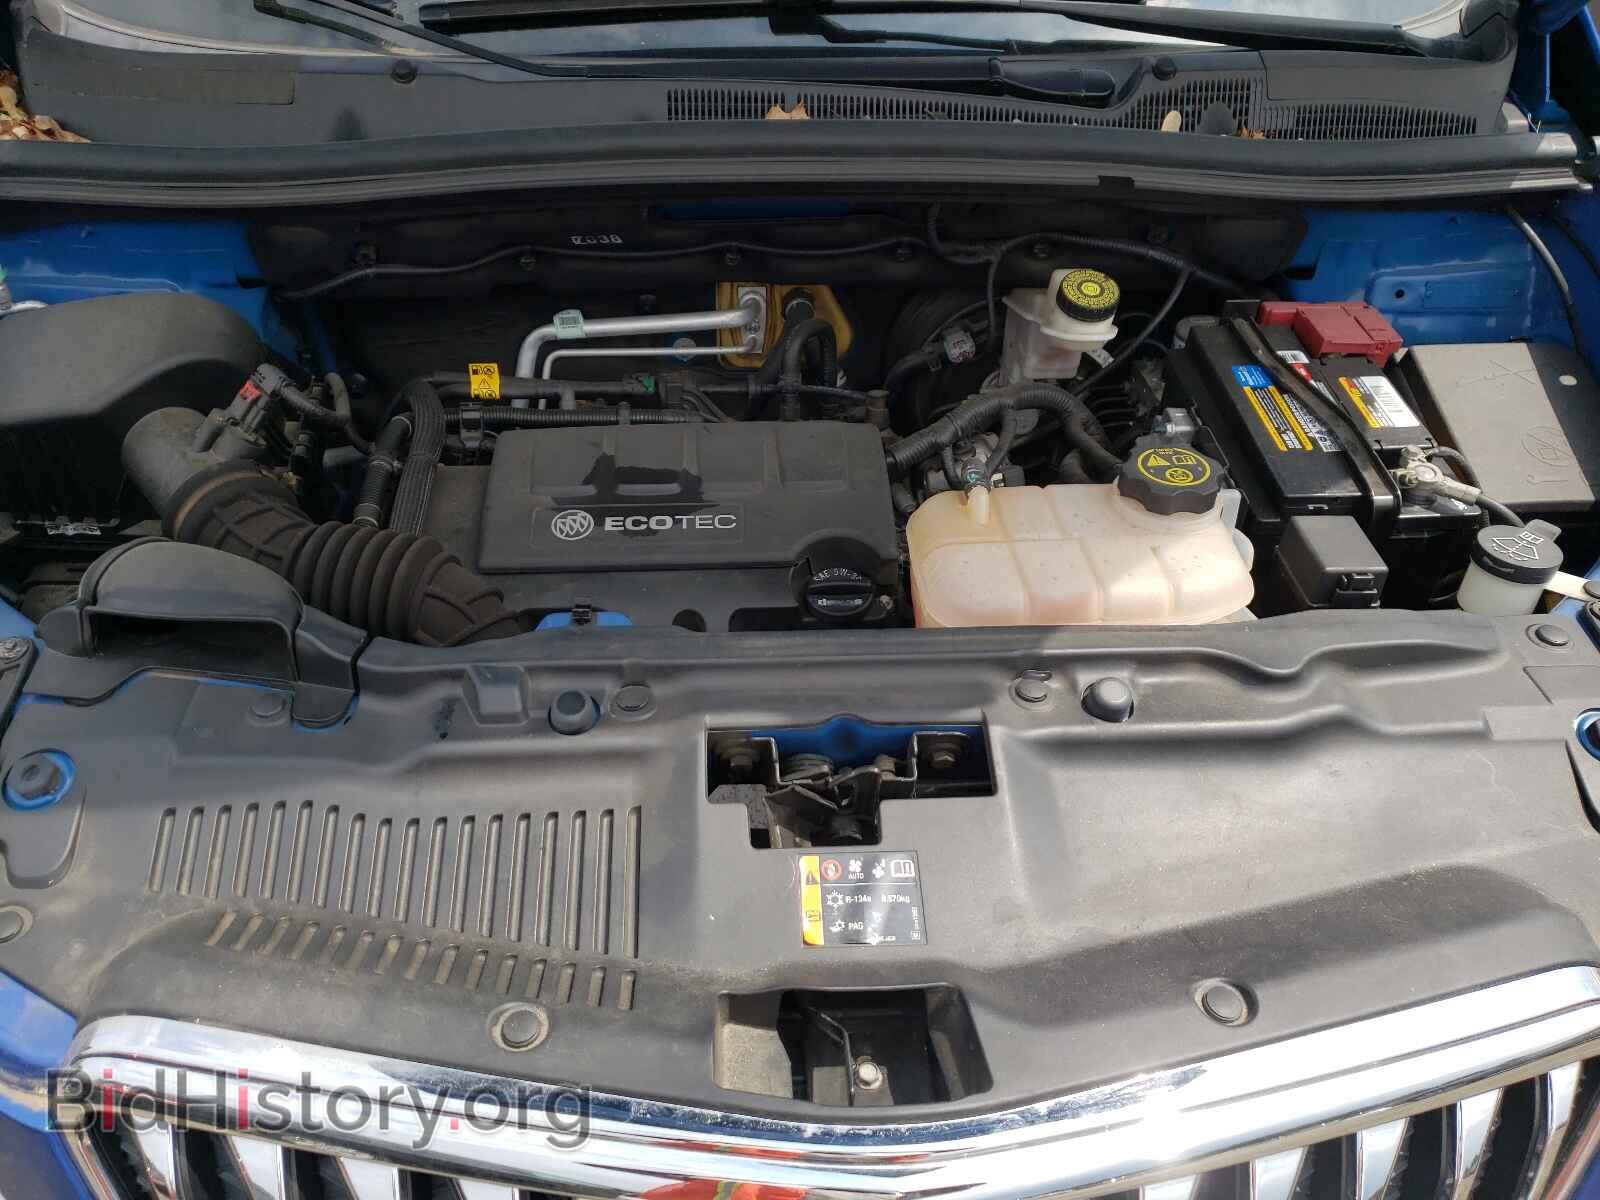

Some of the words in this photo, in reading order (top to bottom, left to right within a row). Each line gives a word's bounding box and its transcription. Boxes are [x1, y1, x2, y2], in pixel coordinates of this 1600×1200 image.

[604, 514, 737, 531] ECOTEC
[848, 872, 864, 880] AUTO
[848, 921, 864, 930] PAG
